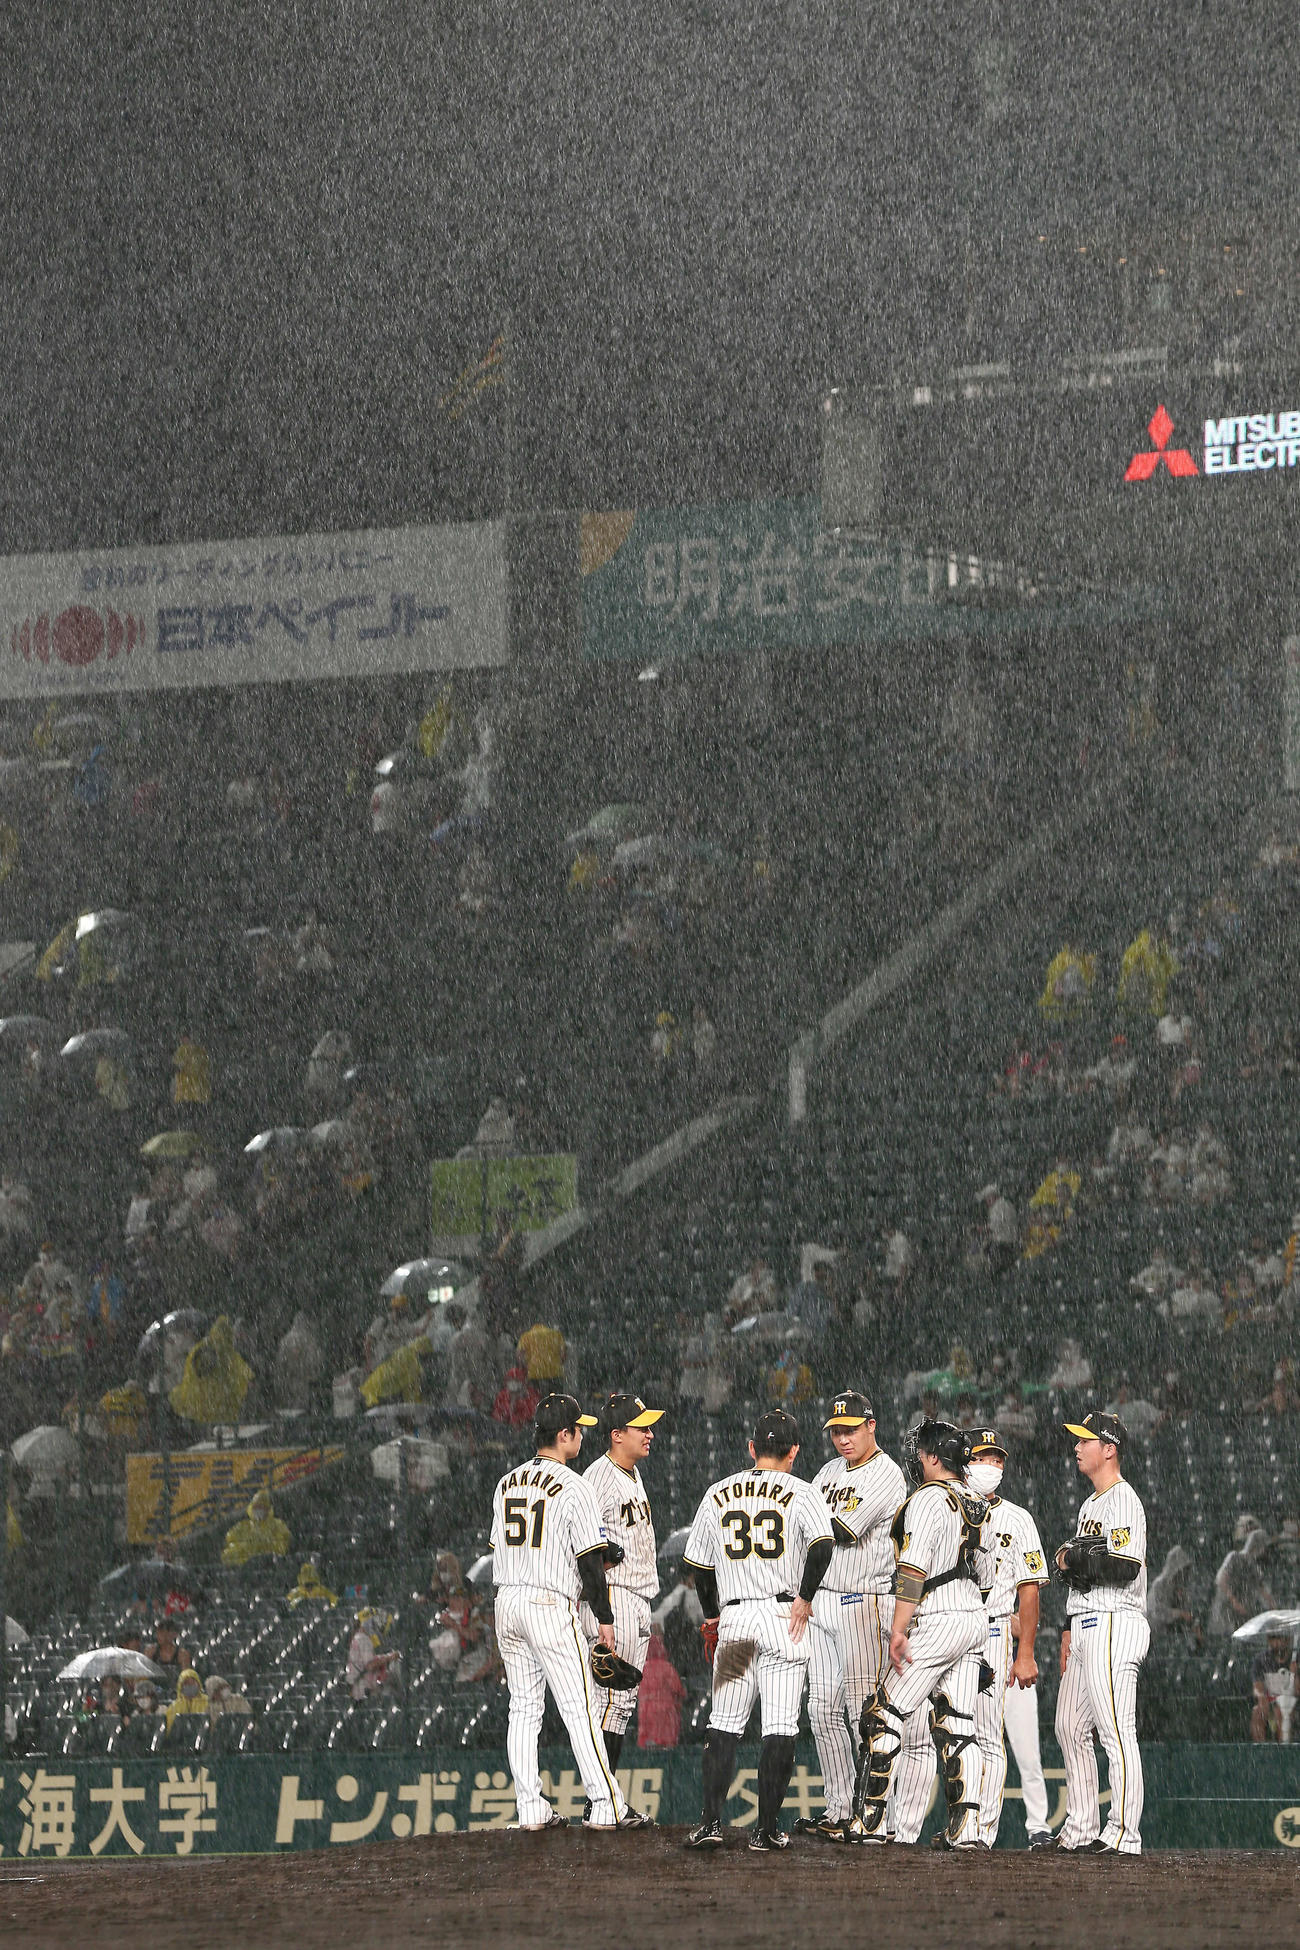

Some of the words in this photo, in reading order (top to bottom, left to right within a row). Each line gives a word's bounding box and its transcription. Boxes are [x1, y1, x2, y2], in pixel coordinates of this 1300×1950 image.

[157, 591, 451, 653] 日本ペイント
[1100, 1429, 1121, 1445] Joshin
[501, 1470, 563, 1498] NAKANO
[713, 1481, 795, 1508] ITOHARA
[504, 1497, 545, 1549] 51
[721, 1509, 785, 1561] 33
[0, 1767, 217, 1857] 海大学
